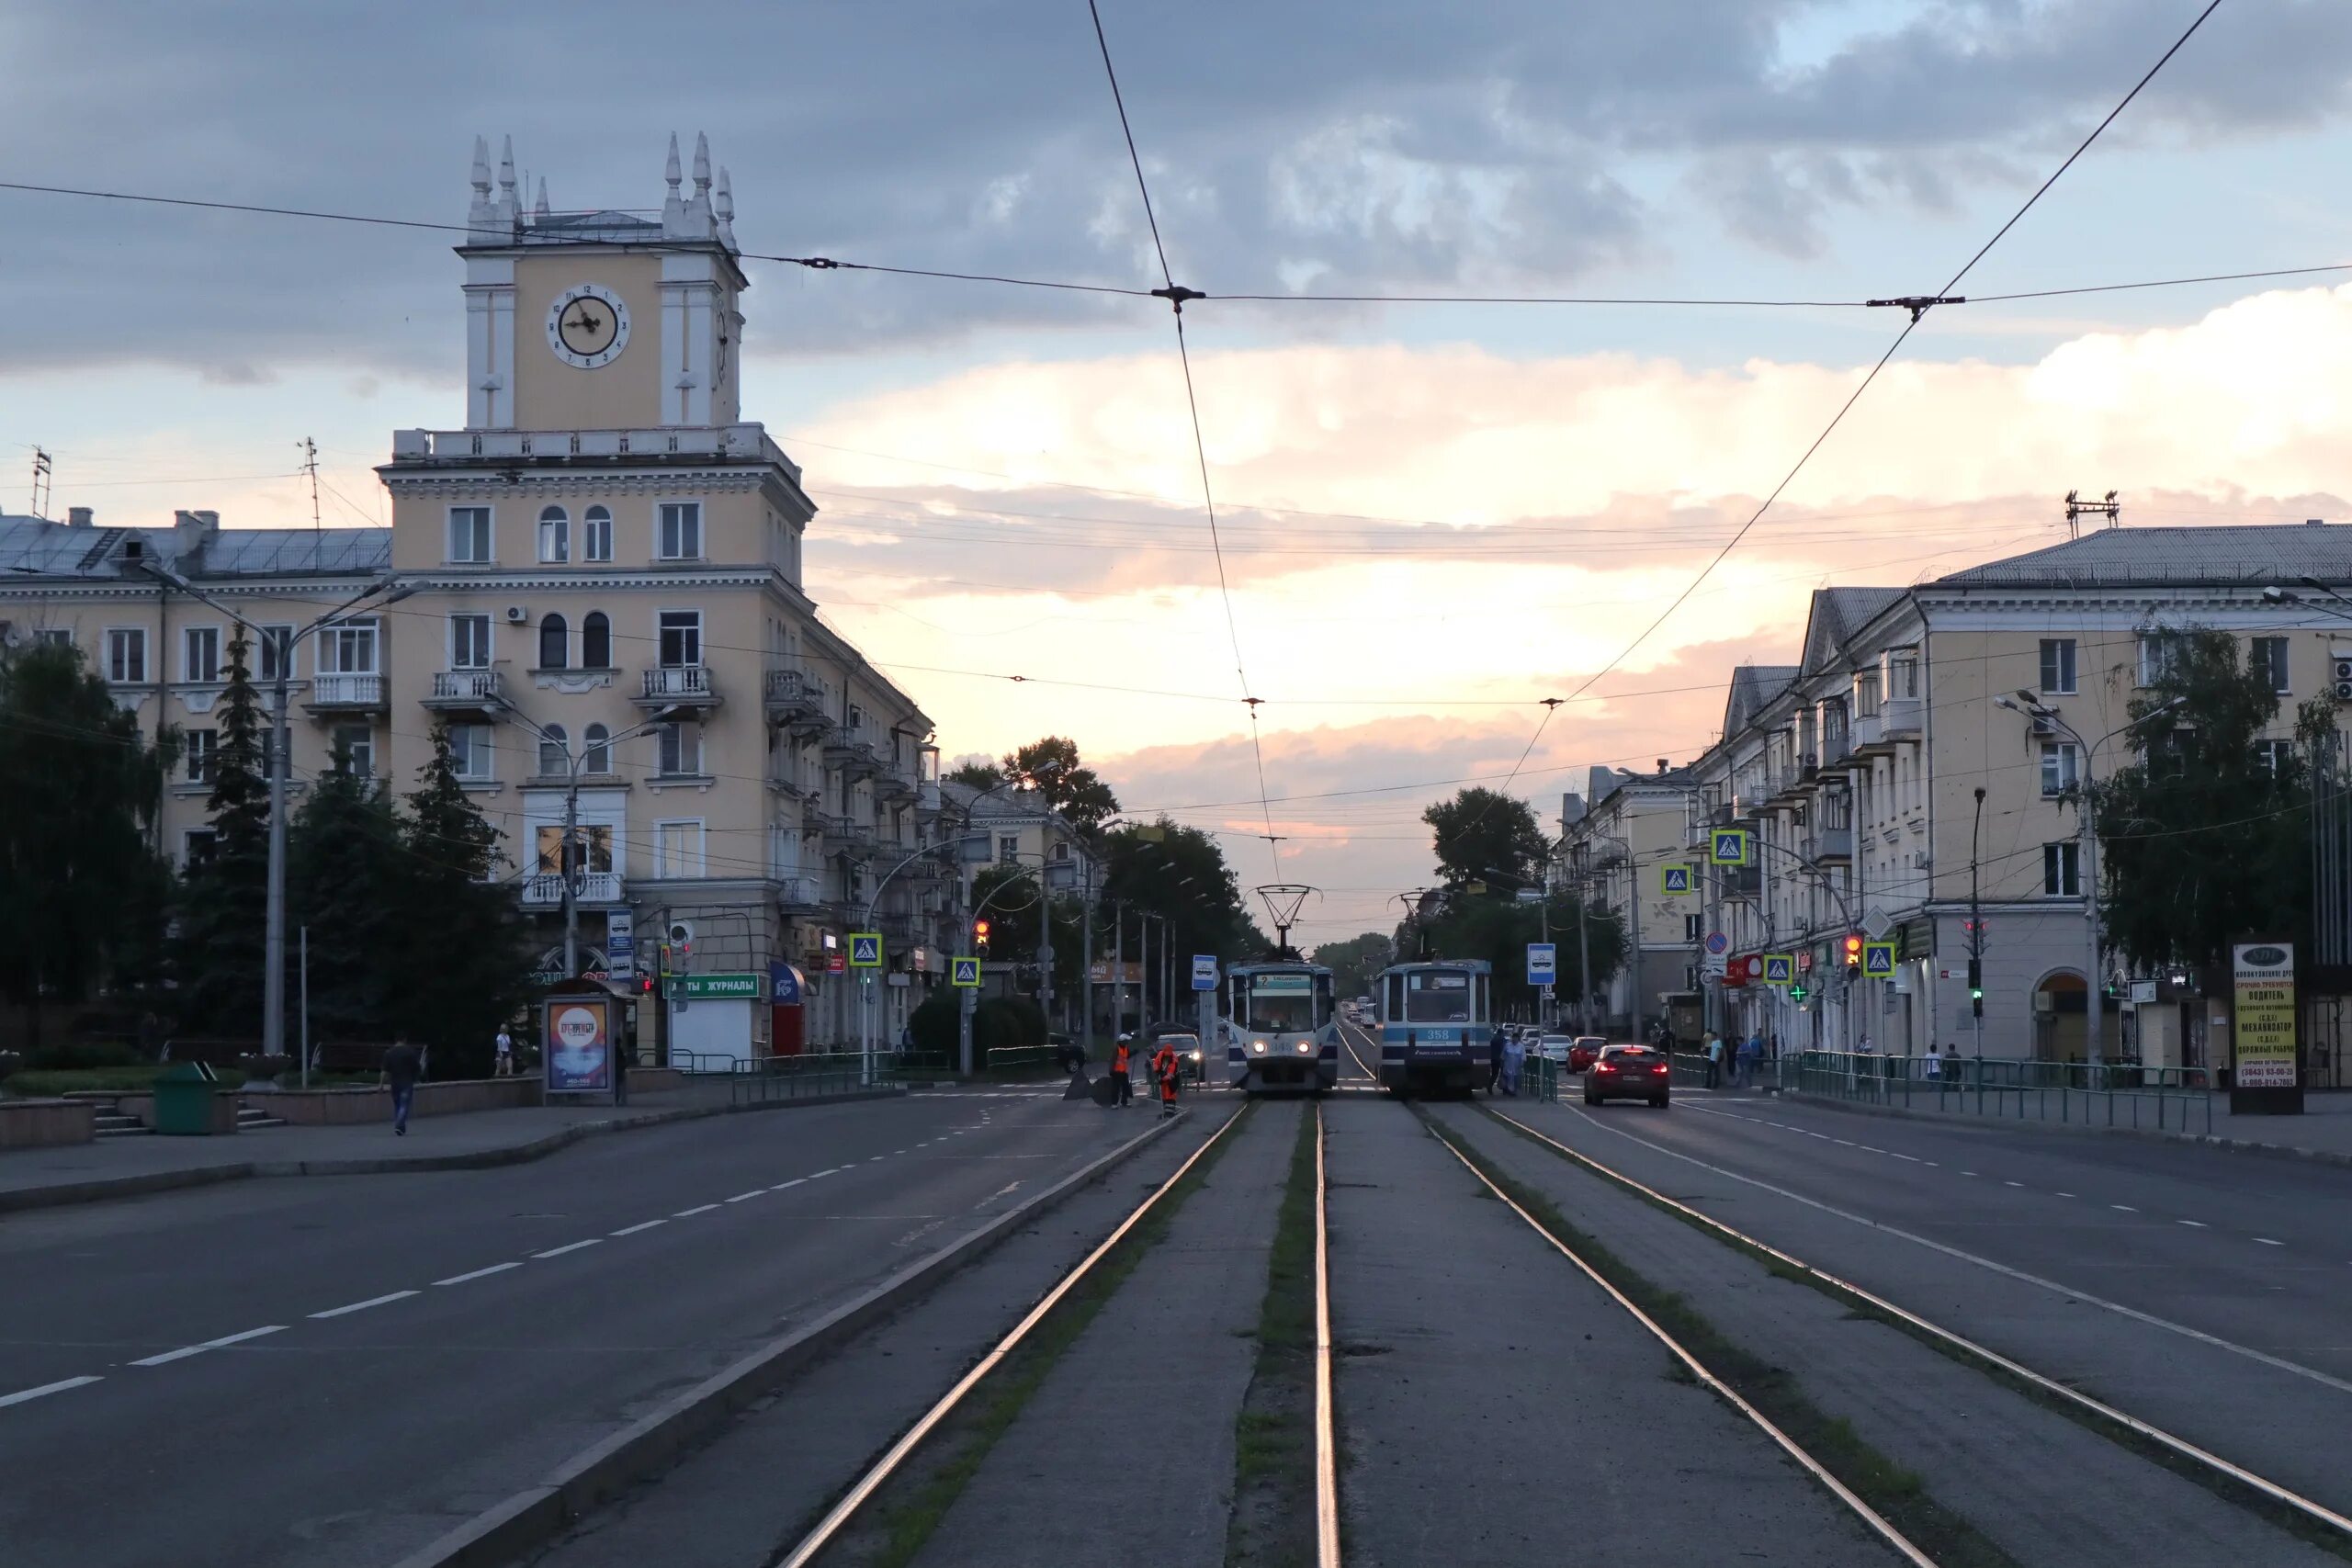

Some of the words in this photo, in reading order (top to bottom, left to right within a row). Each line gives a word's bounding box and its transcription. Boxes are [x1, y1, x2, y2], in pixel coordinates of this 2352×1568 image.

[549, 322, 554, 331] 9
[622, 321, 627, 330] 3
[707, 980, 754, 991] ЖУРНАЛЫ
[1261, 976, 1268, 986] 2
[2248, 990, 2285, 1001] ВОДИТЕЛЬ
[2242, 1021, 2292, 1032] МЕХАНИЗАТОР
[1427, 1029, 1449, 1040] 358
[2238, 1045, 2271, 1054] ДОРОЖНЫЕ
[2242, 1068, 2264, 1077] (3843)
